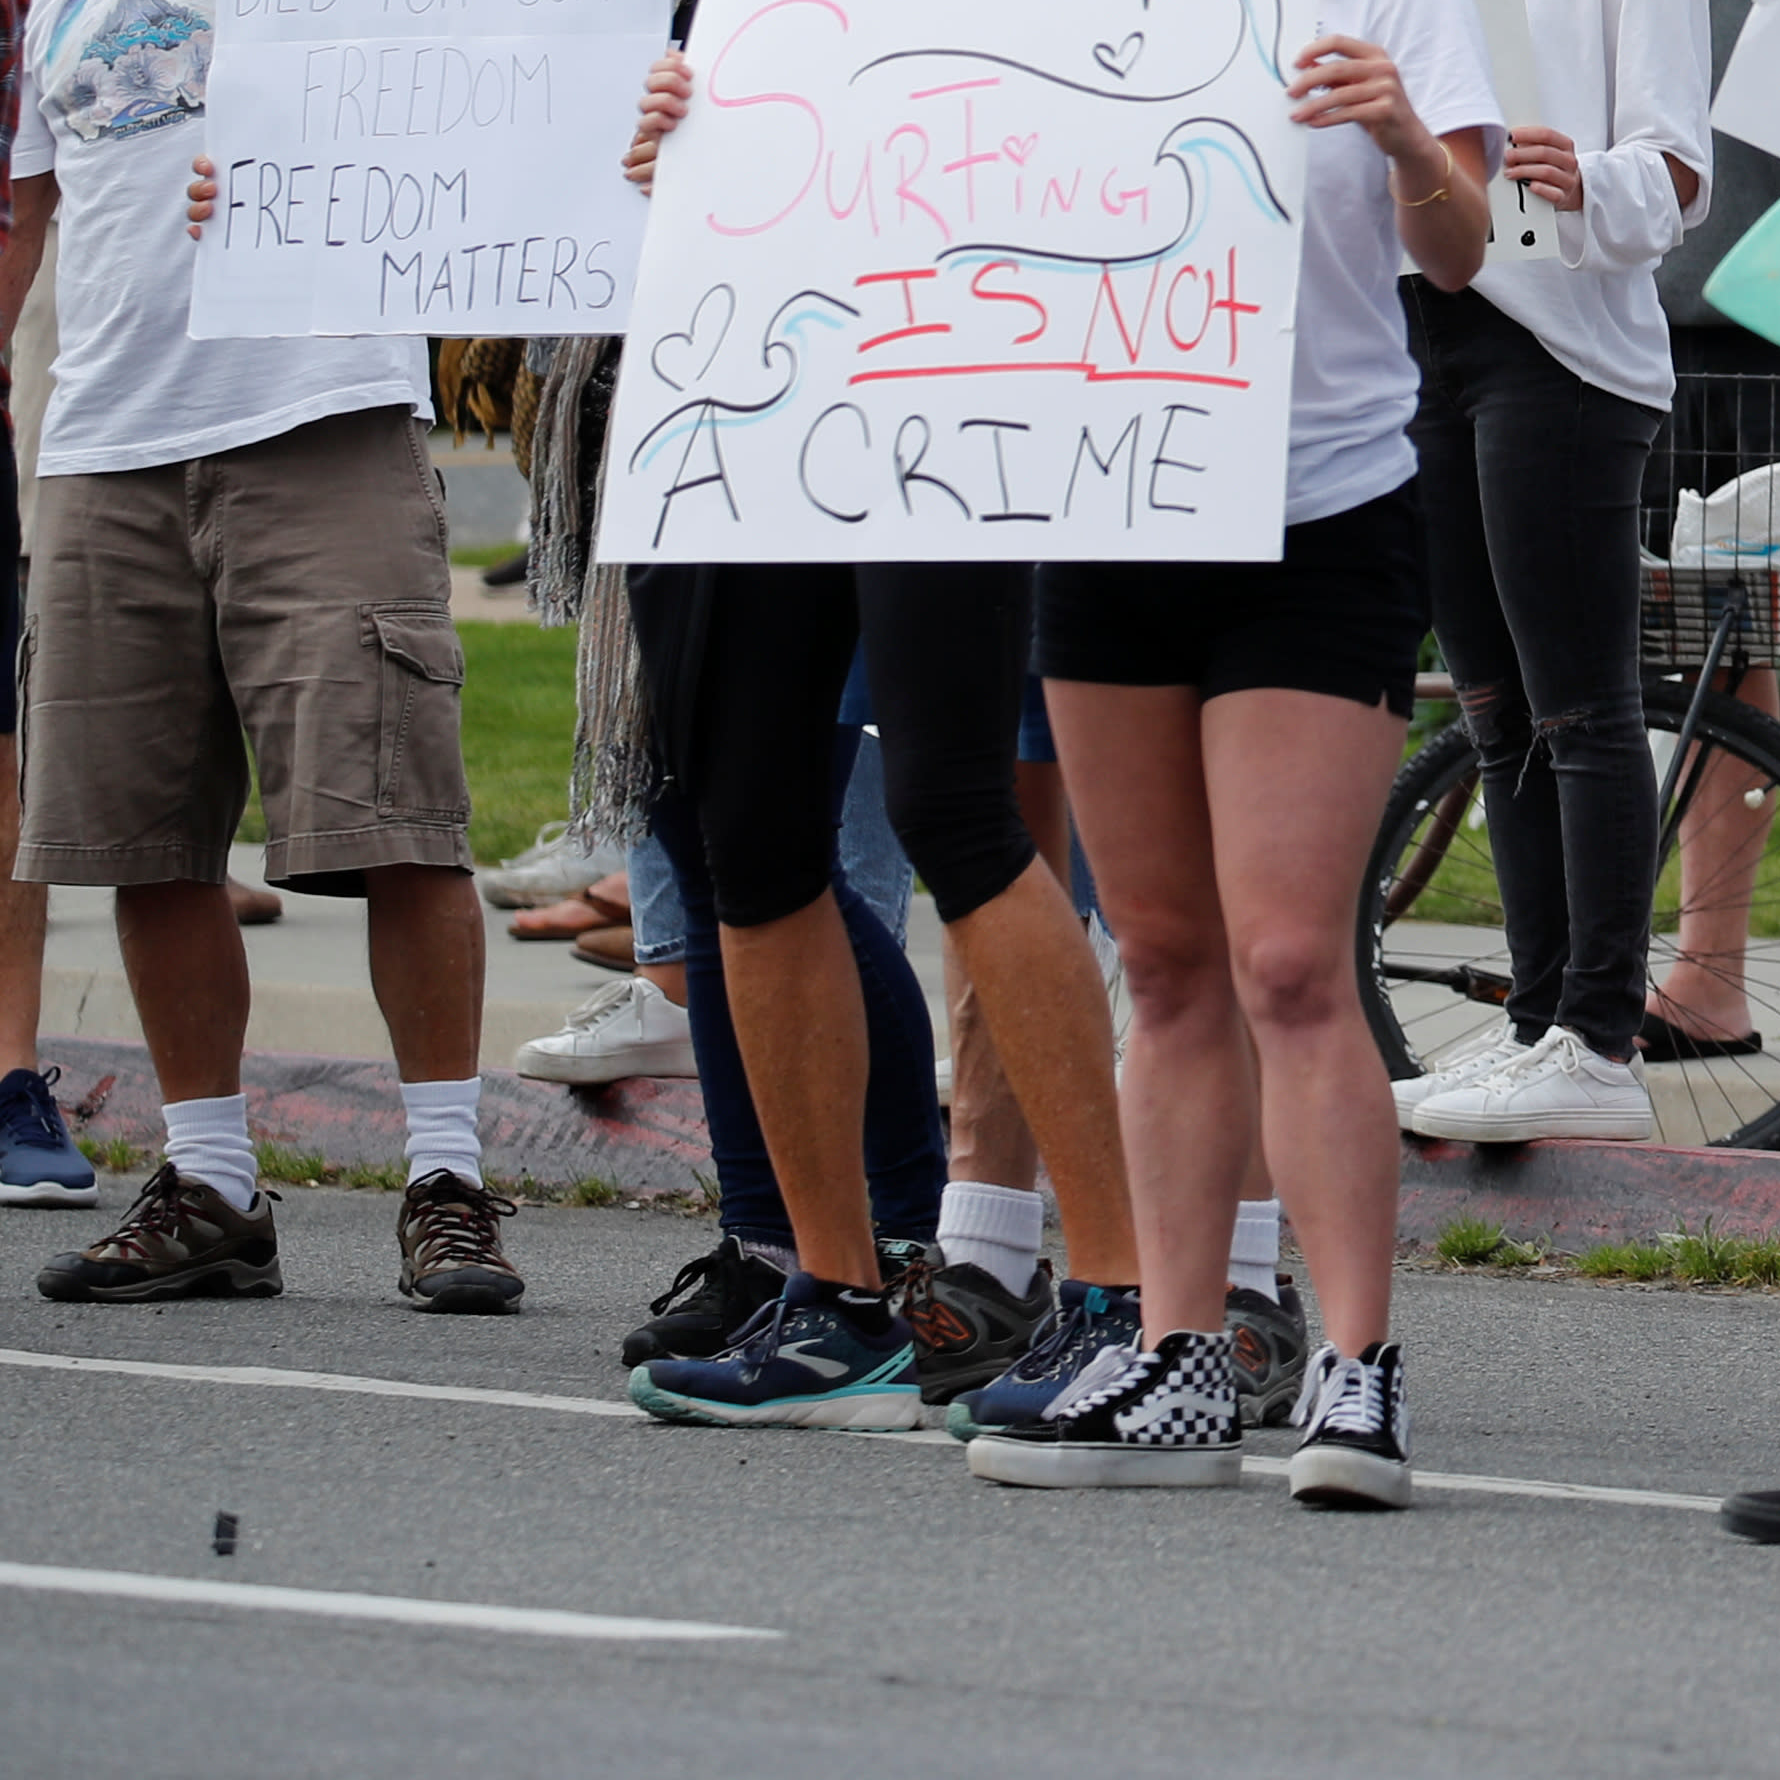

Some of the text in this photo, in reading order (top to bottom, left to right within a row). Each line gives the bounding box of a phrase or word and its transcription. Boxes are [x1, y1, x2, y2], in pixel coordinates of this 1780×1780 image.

[301, 45, 553, 144] FREEDOM
[224, 157, 469, 250] FREEDOM
[379, 235, 617, 317] MATTERS
[855, 256, 1050, 353] IS
[652, 397, 1211, 550] A CRIME
